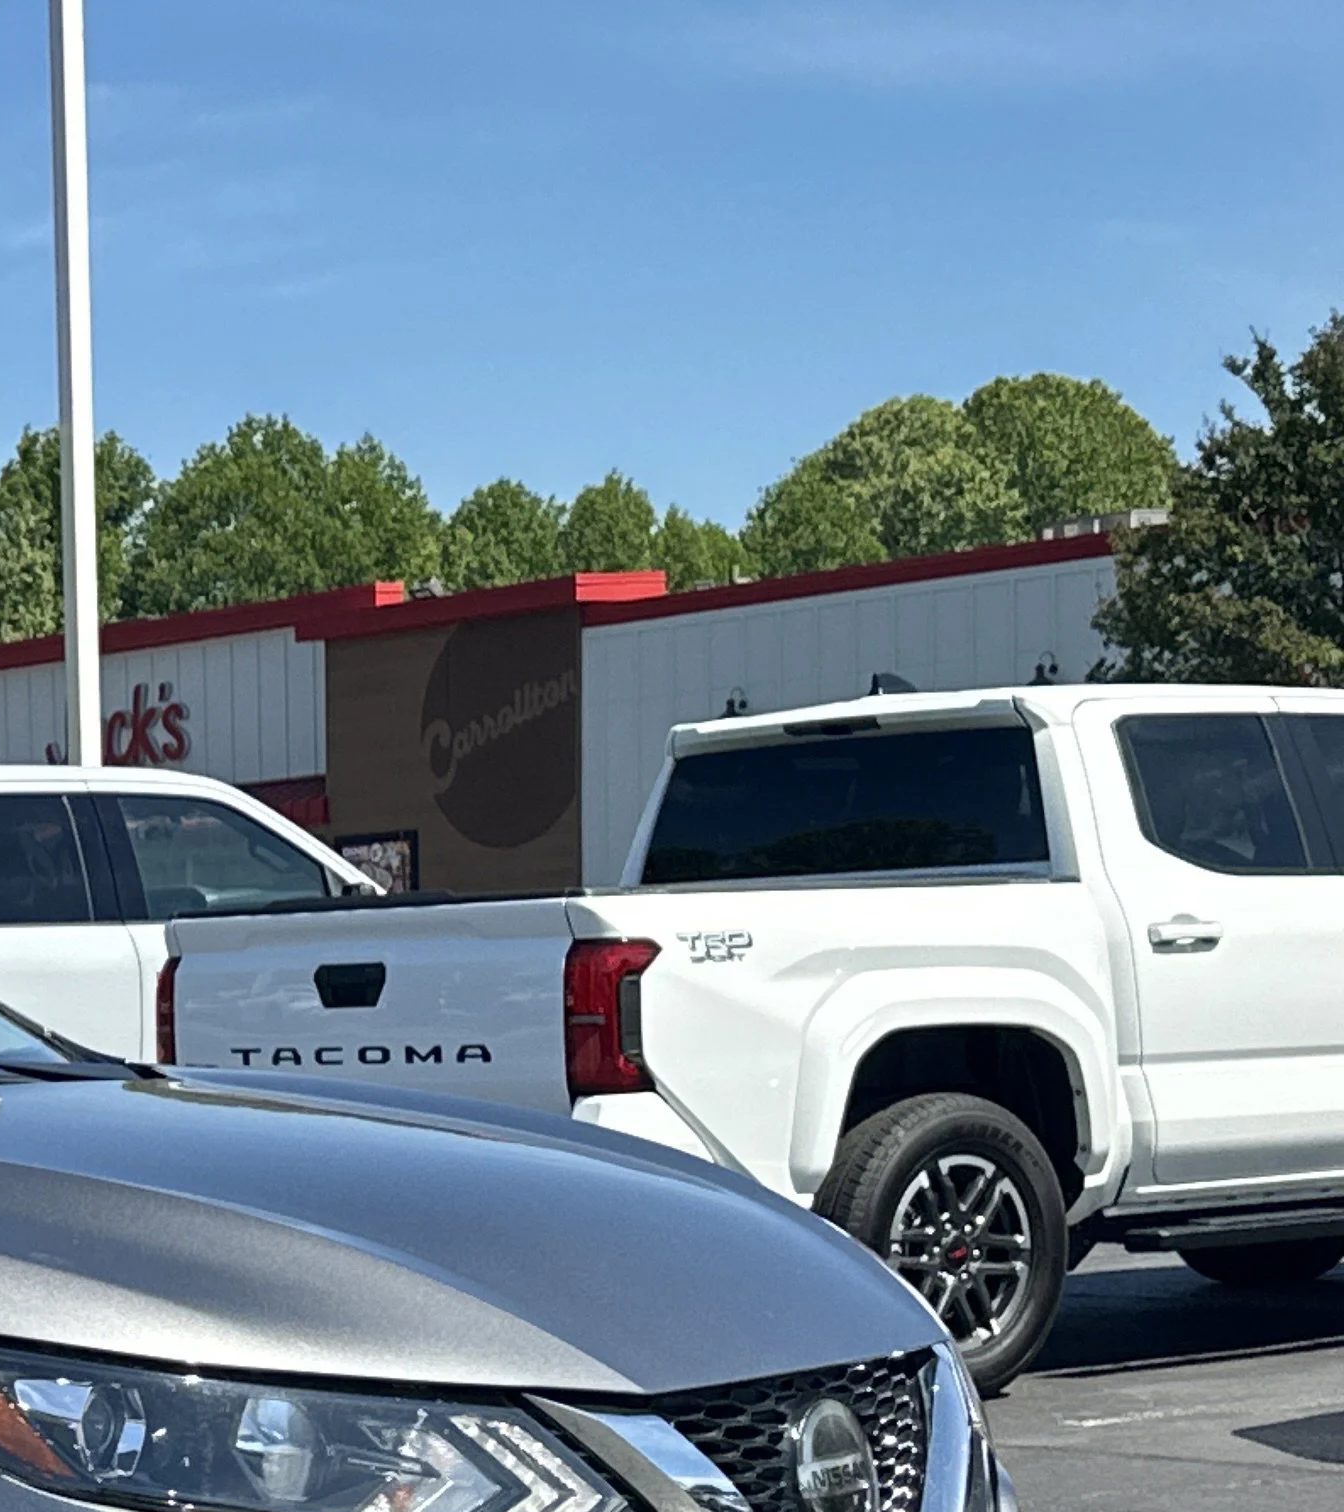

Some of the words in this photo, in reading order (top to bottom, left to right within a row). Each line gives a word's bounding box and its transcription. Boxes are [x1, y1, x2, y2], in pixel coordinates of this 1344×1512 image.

[46, 682, 184, 763] ck's
[421, 669, 578, 794] Carrollton
[230, 1044, 492, 1067] TACOMA
